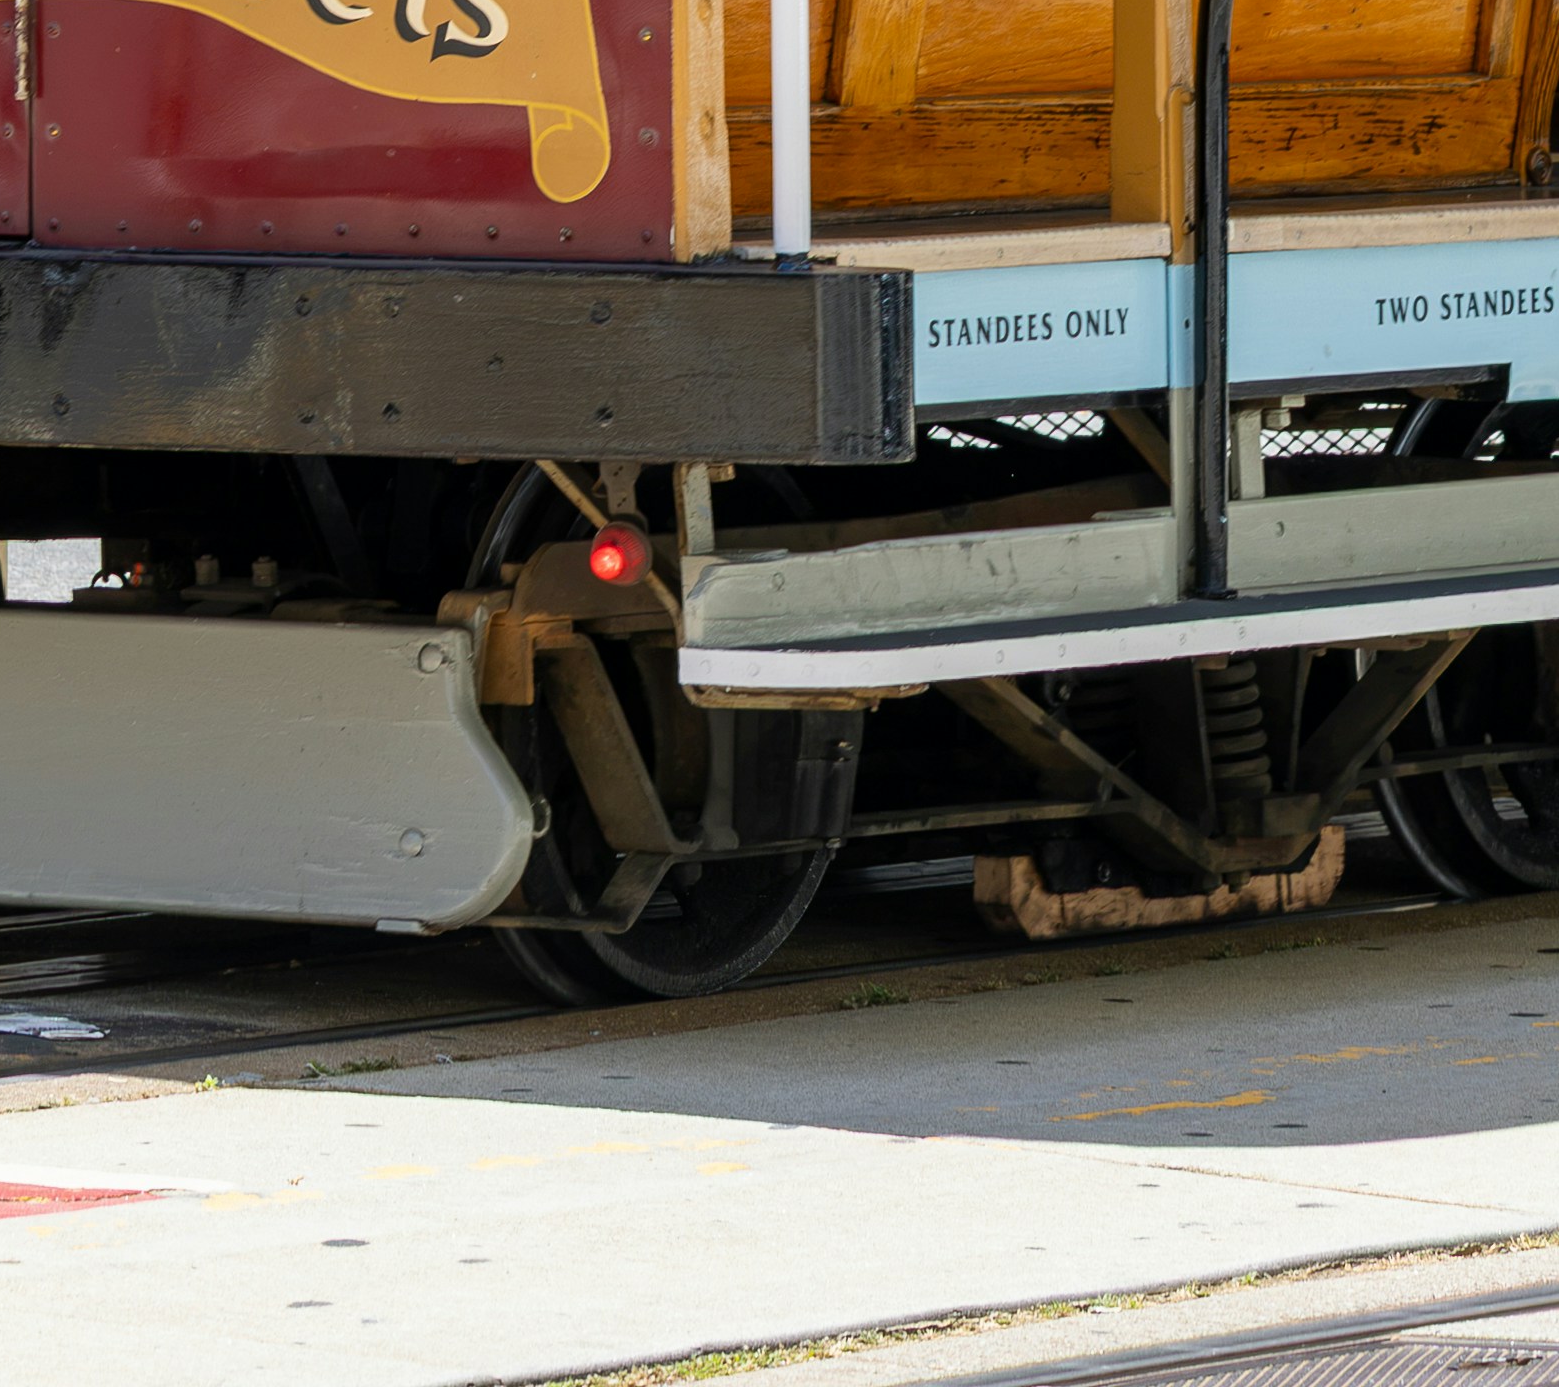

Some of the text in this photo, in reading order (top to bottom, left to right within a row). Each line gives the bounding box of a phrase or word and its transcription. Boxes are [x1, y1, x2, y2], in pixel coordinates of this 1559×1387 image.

[1375, 296, 1428, 326] TWO
[1440, 286, 1555, 322] STANDEES
[928, 307, 1130, 348] STANDEES ONLY
